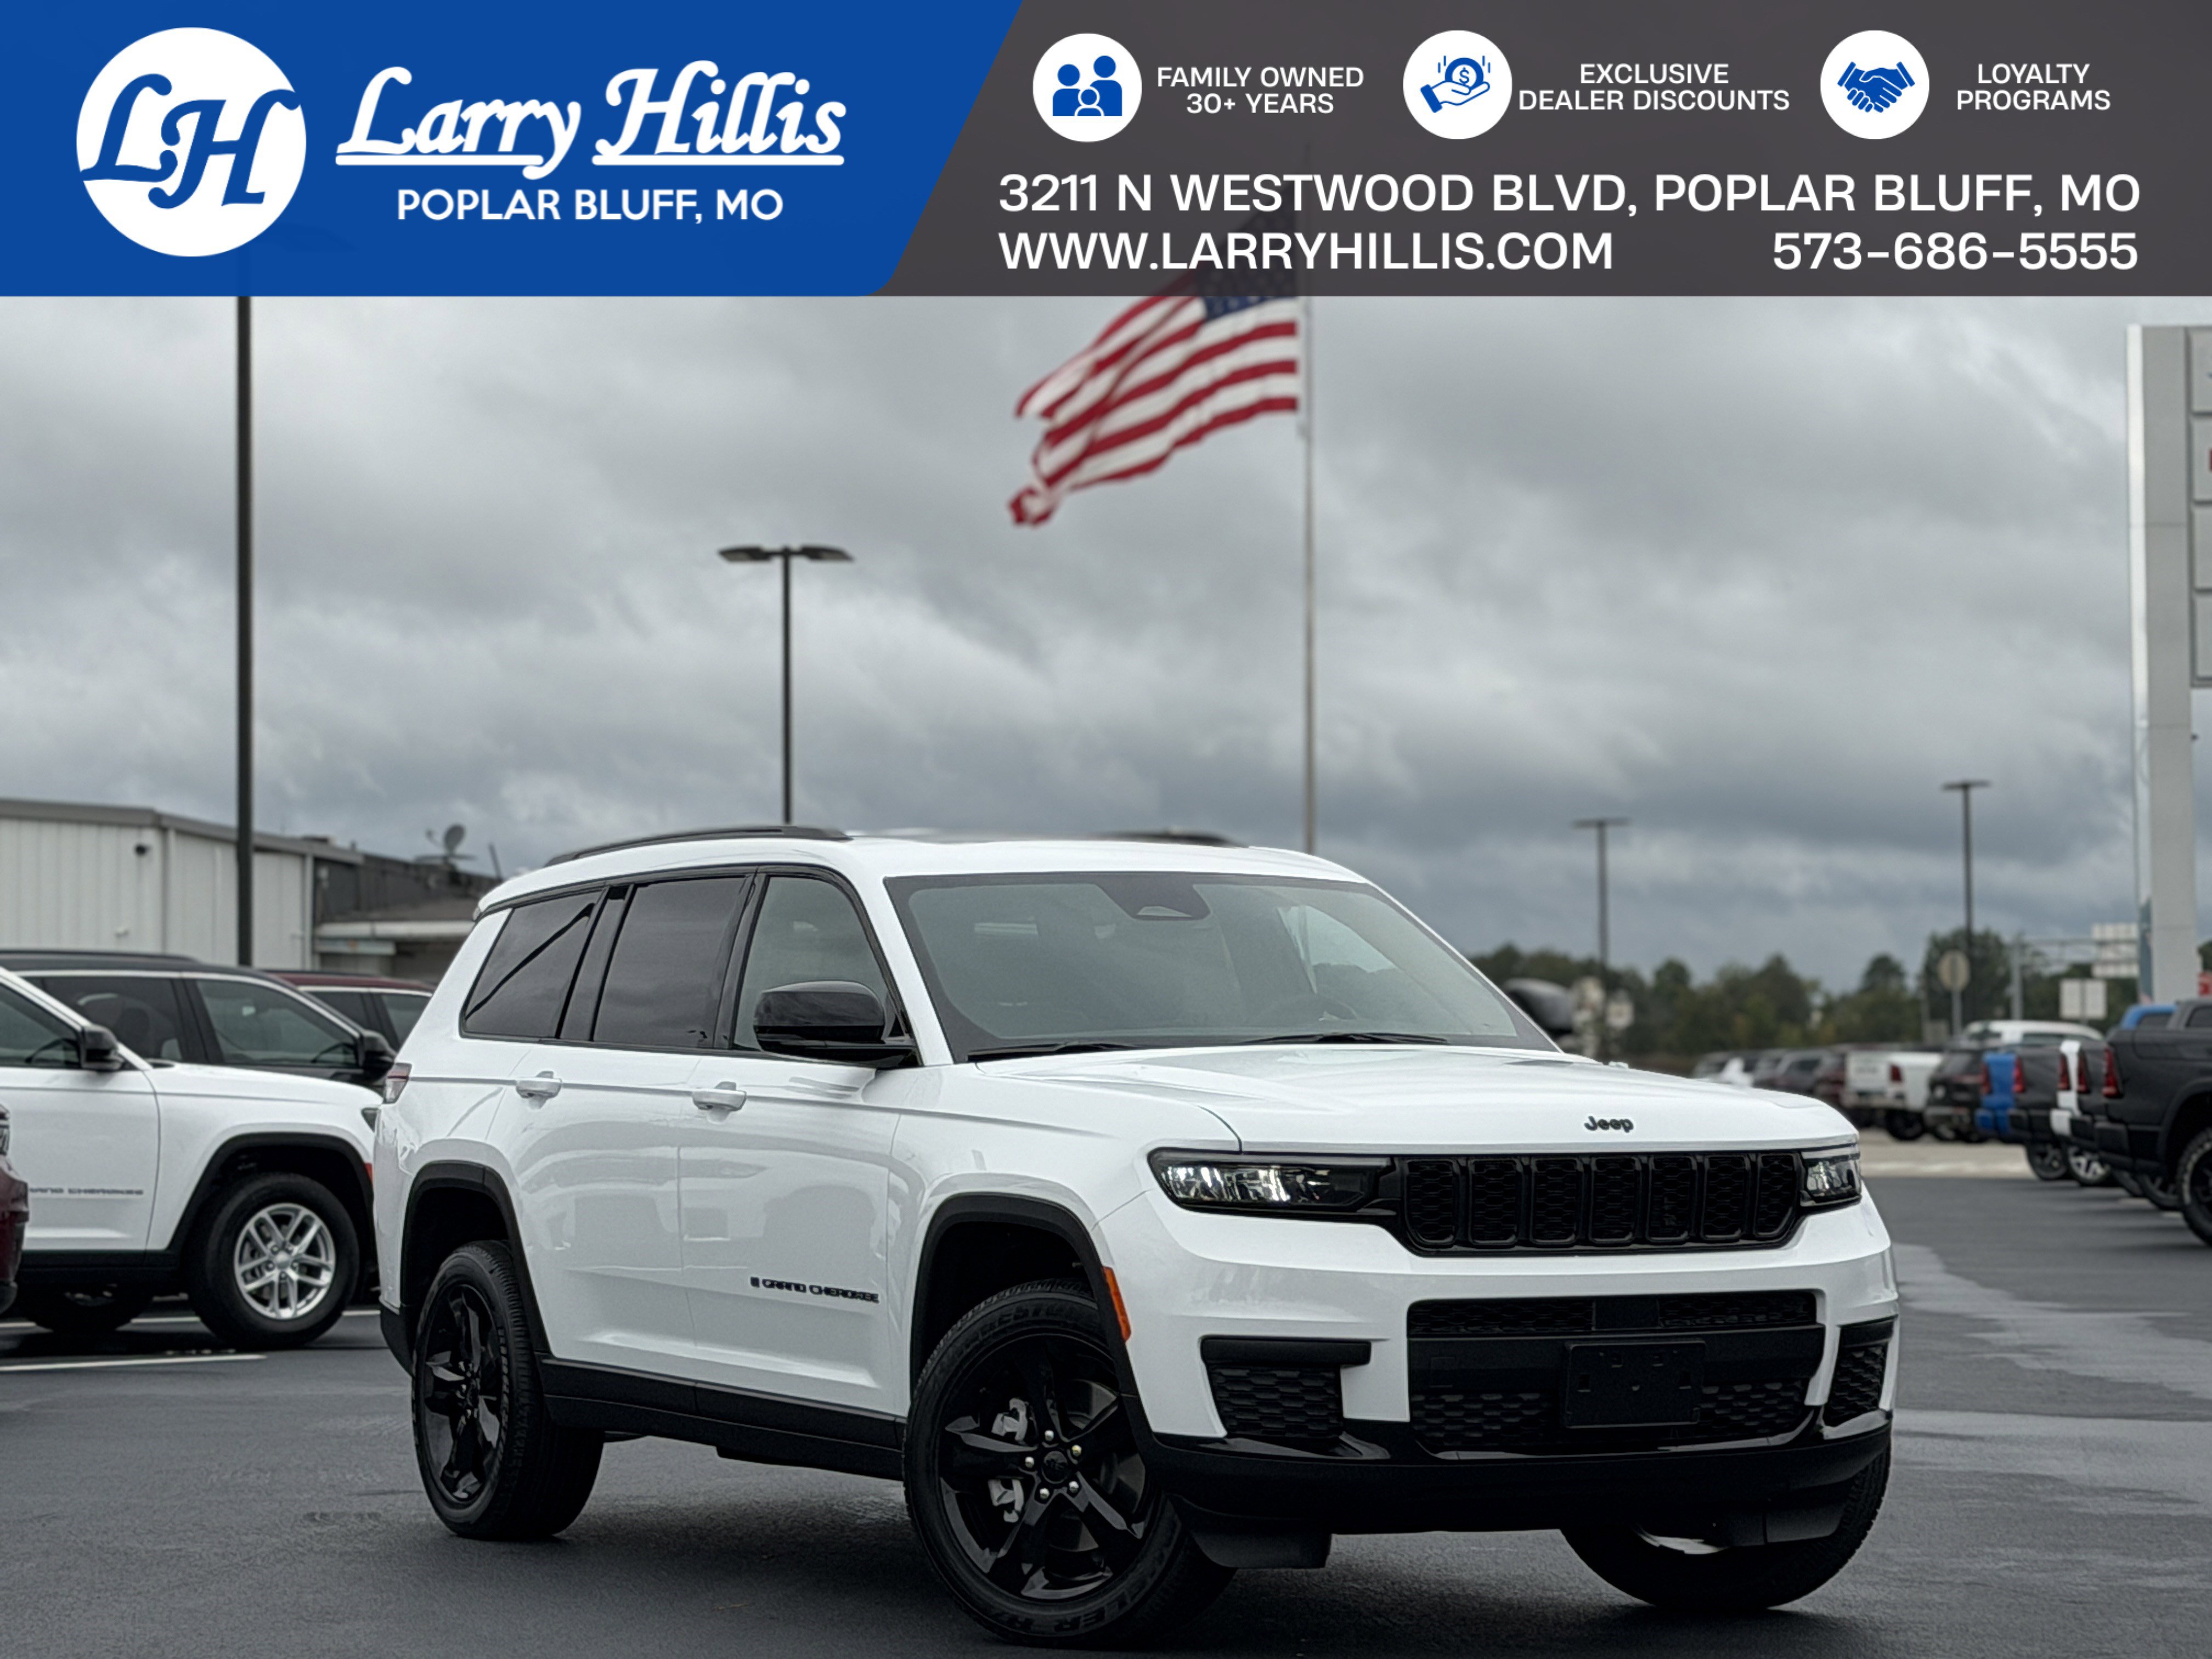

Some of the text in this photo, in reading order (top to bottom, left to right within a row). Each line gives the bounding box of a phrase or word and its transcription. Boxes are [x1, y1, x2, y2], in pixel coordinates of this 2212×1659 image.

[1583, 1115, 1634, 1133] Jeep
[762, 1279, 879, 1304] GRAND CHEROKEE
